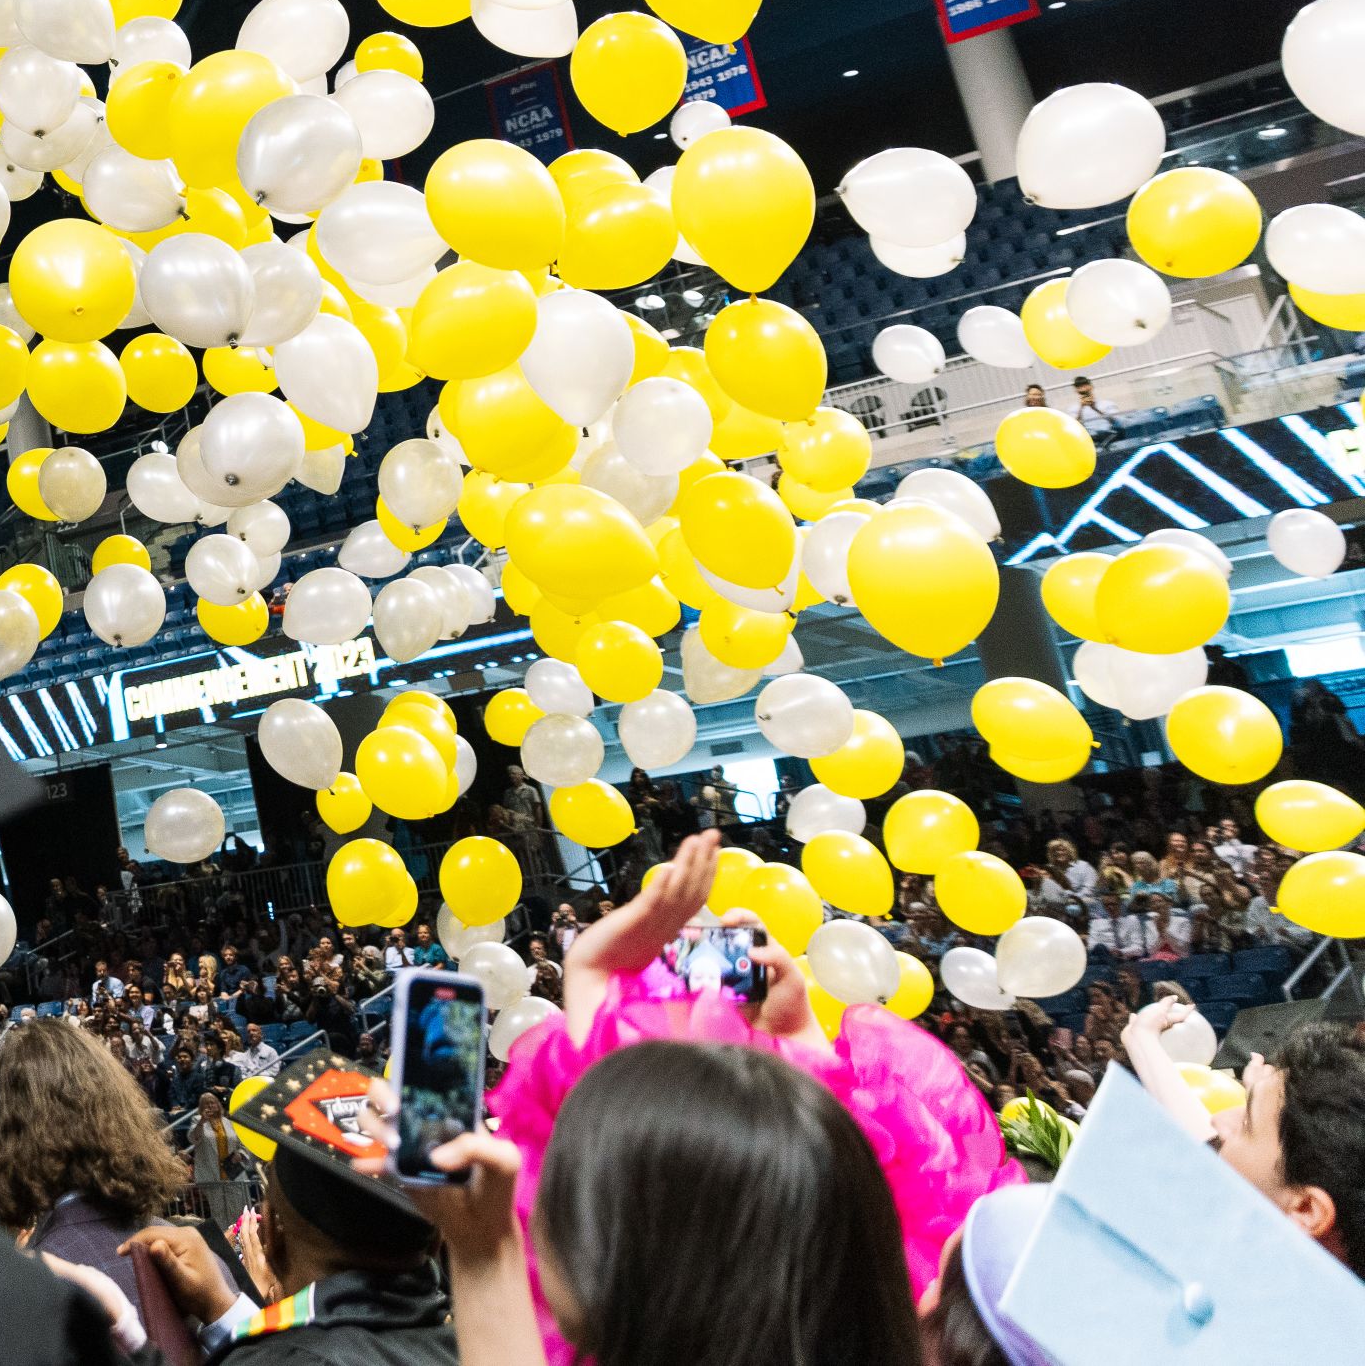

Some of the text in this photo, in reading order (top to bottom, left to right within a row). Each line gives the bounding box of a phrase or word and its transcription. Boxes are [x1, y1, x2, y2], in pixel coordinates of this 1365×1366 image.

[685, 76, 714, 93] 1943
[505, 106, 553, 132] NCAA
[535, 128, 563, 143] 1979
[124, 636, 376, 722] COMMENCEMENT 2023
